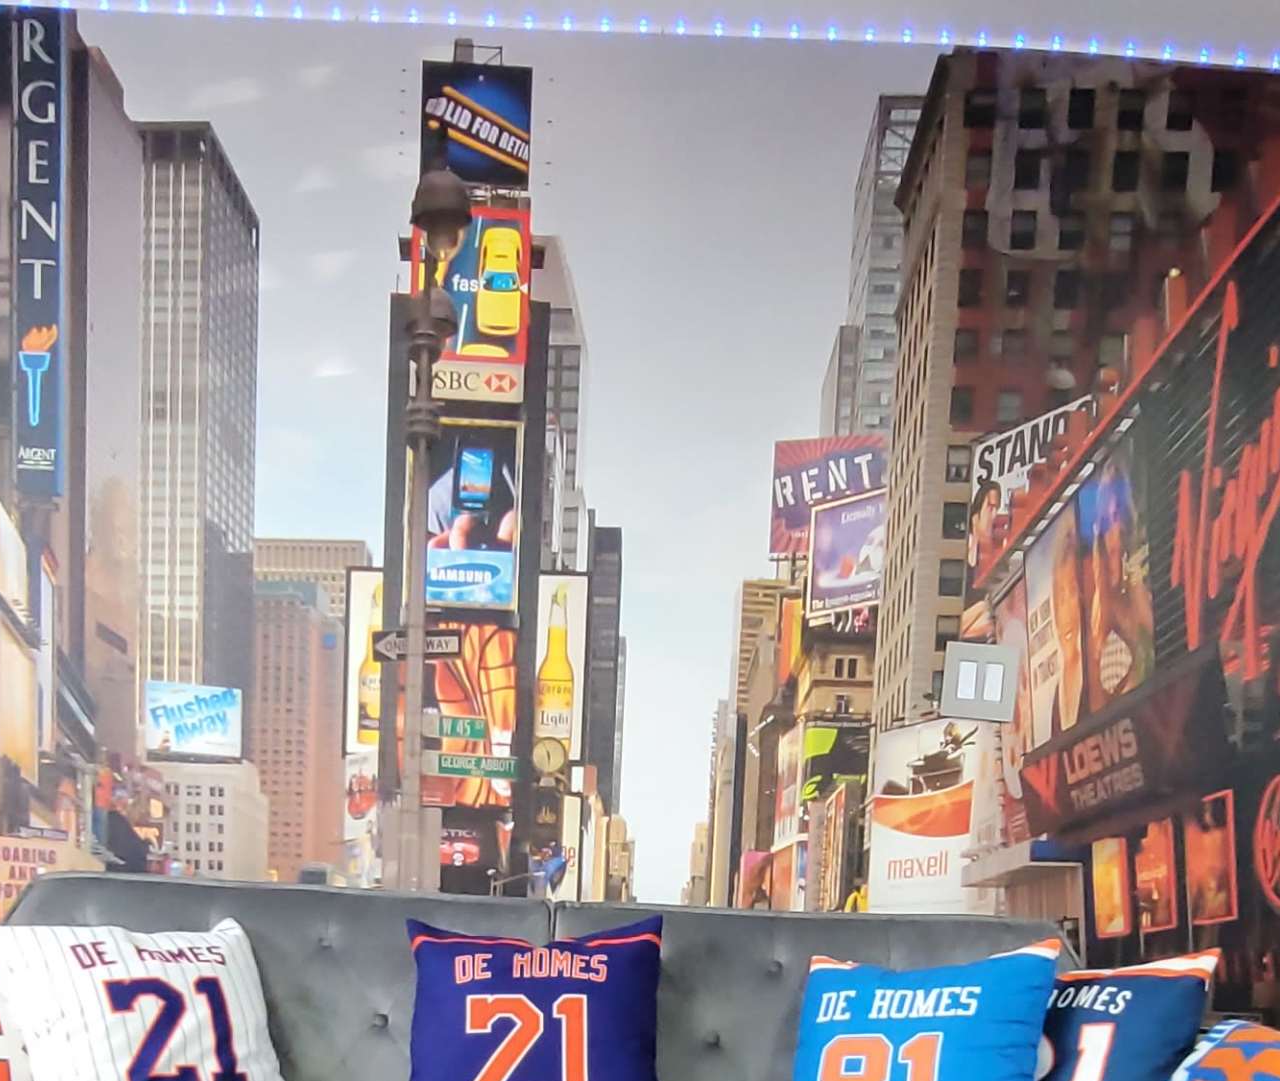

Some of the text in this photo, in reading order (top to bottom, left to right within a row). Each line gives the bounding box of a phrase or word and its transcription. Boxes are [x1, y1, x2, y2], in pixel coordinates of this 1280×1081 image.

[471, 116, 500, 145] FOR
[433, 370, 480, 392] SBC
[774, 453, 873, 508] RENT
[429, 567, 493, 584] SAMSUNG
[425, 639, 451, 650] WAY
[456, 720, 471, 736] 45
[887, 850, 949, 881] maxell
[70, 941, 117, 970] DE
[454, 947, 608, 984] DE HOMES
[816, 985, 982, 1023] DE HOMES
